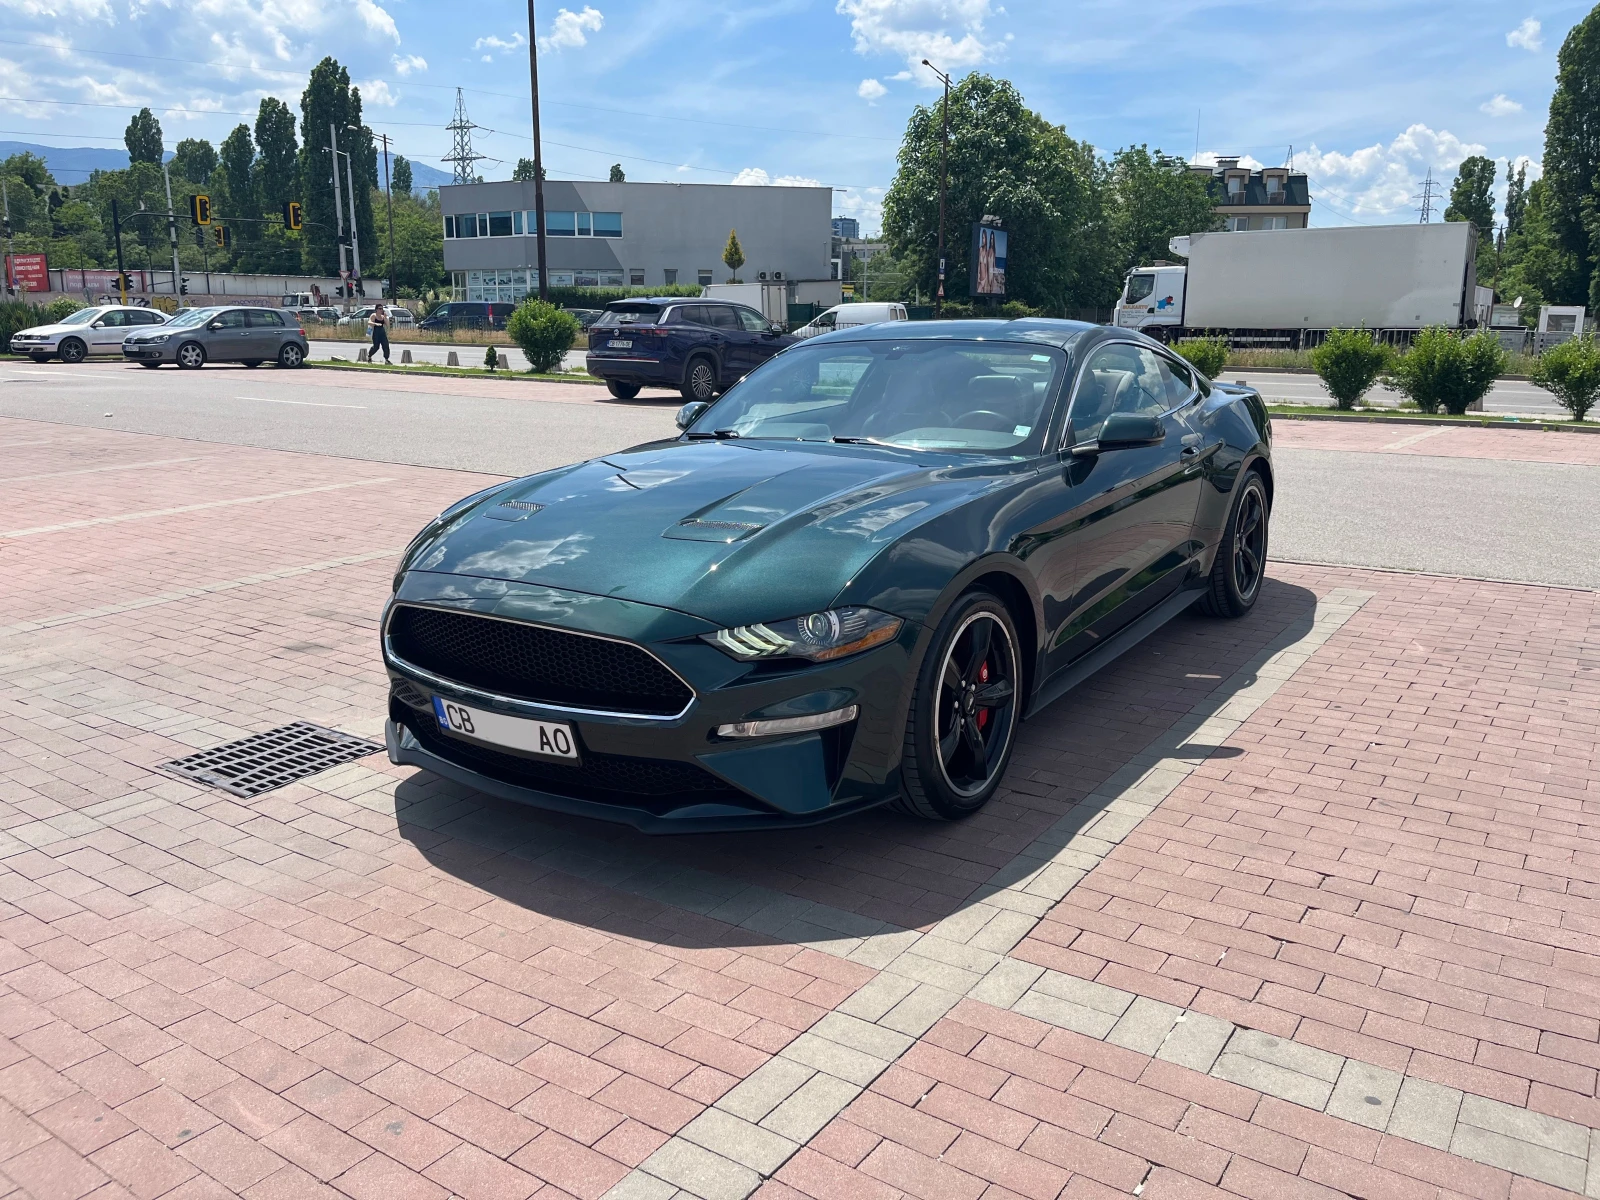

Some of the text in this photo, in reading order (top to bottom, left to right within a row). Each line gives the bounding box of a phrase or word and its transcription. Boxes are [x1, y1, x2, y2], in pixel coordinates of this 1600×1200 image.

[438, 715, 448, 726] BG
[446, 704, 571, 755] CB AO
